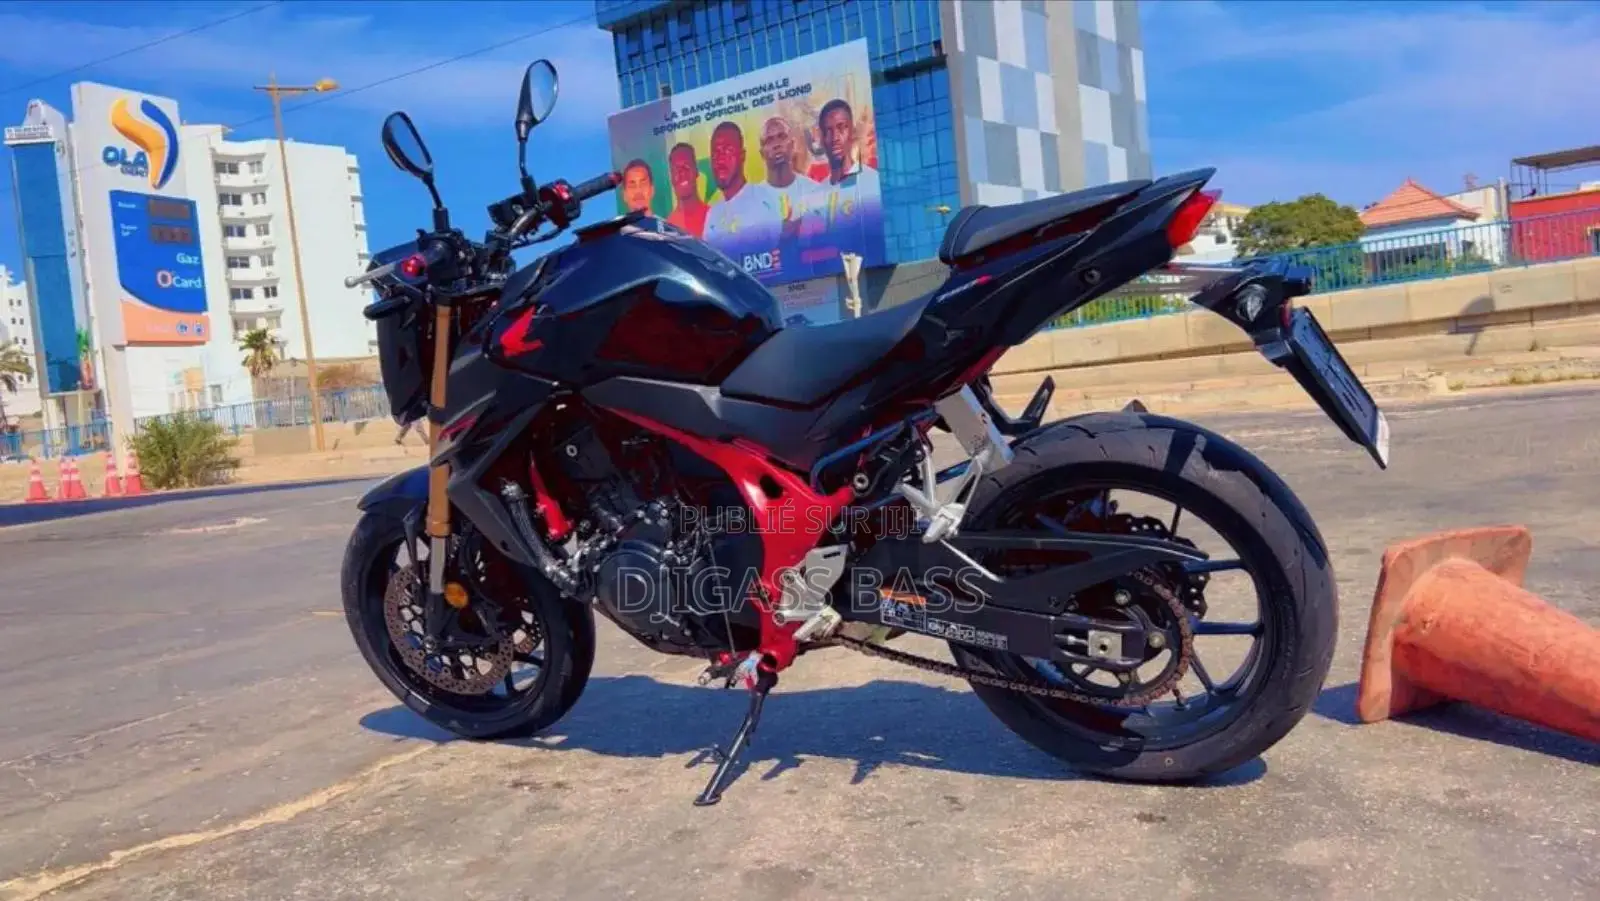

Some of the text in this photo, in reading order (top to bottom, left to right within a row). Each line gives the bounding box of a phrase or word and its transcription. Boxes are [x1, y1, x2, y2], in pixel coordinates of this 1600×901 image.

[653, 83, 812, 136] SPONSOR OFFICIEL DES LIONS
[682, 95, 725, 117] BANQUE
[727, 78, 790, 102] NATIONALE
[103, 146, 148, 168] OLA
[176, 252, 200, 265] Gaz
